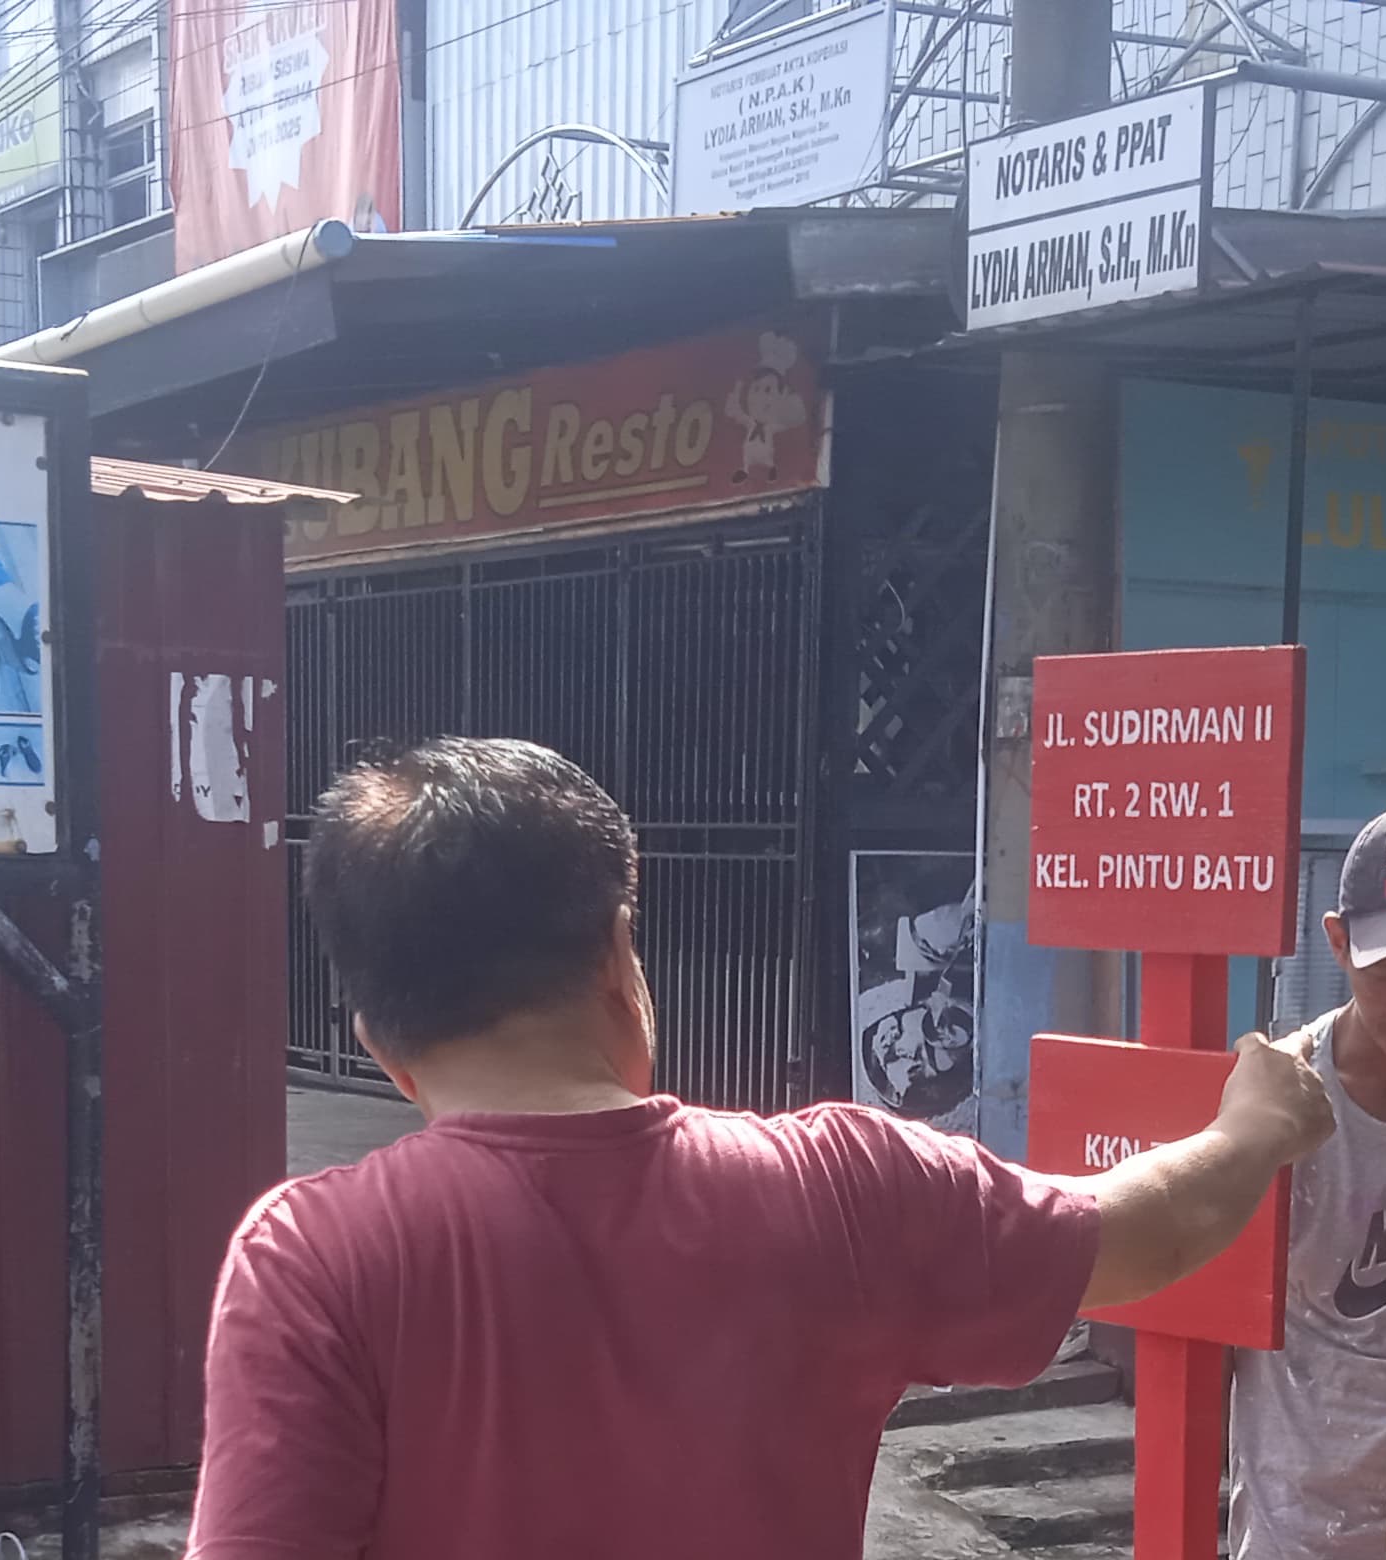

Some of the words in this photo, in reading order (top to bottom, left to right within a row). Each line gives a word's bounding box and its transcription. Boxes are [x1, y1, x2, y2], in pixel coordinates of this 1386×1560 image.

[704, 122, 737, 151] LYDIA
[740, 108, 786, 140] ARMAN,
[820, 85, 852, 113] M.Kn
[996, 135, 1086, 200] NOTARIS
[1093, 130, 1107, 176] &
[1115, 113, 1173, 172] PPAT
[971, 246, 1019, 311] LYDIA
[1022, 230, 1093, 301] ARMAN,
[1146, 209, 1196, 276] M.Kn
[541, 392, 713, 487] Resto
[1044, 713, 1076, 749] JL.
[1084, 705, 1245, 748] SUDIRMAN
[1255, 704, 1273, 742] II
[1074, 782, 1116, 819] RT.
[1125, 782, 1141, 818] 2
[1149, 782, 1208, 819] RW.
[1218, 781, 1235, 818] 1
[1036, 853, 1089, 889] KEL.
[1098, 853, 1184, 890] PINTU
[1193, 854, 1275, 892] BATU
[1084, 1133, 1142, 1169] KKN
